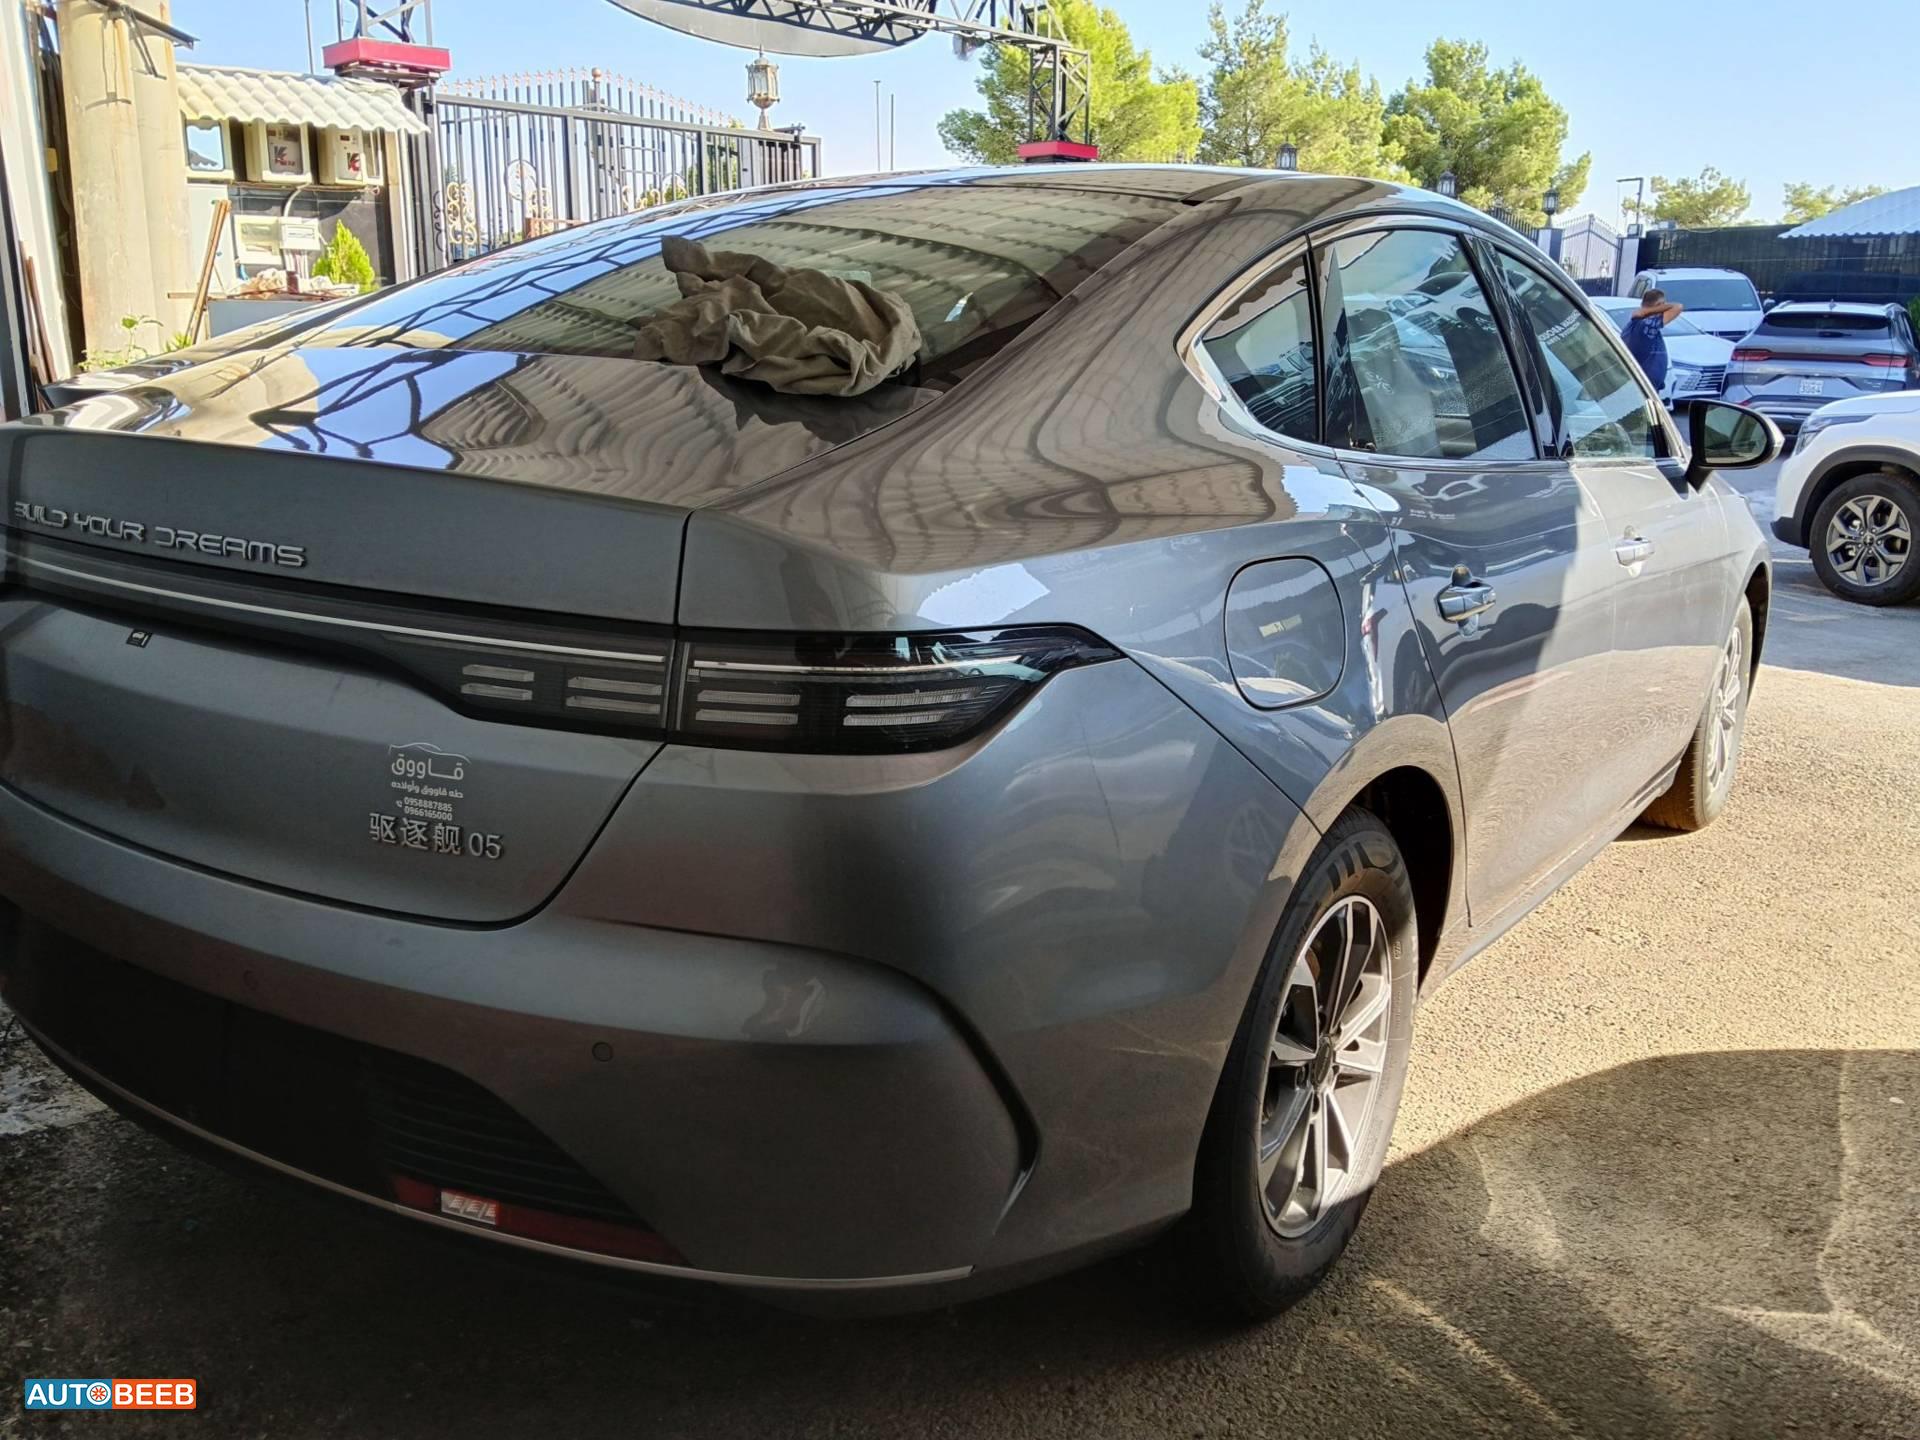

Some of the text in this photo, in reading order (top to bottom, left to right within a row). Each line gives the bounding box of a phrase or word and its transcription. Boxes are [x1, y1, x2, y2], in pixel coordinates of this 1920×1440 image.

[14, 501, 306, 568] BUILD YOUR DREAMS
[391, 753, 464, 780] قاووق
[369, 812, 502, 859] 驱逐舰 05
